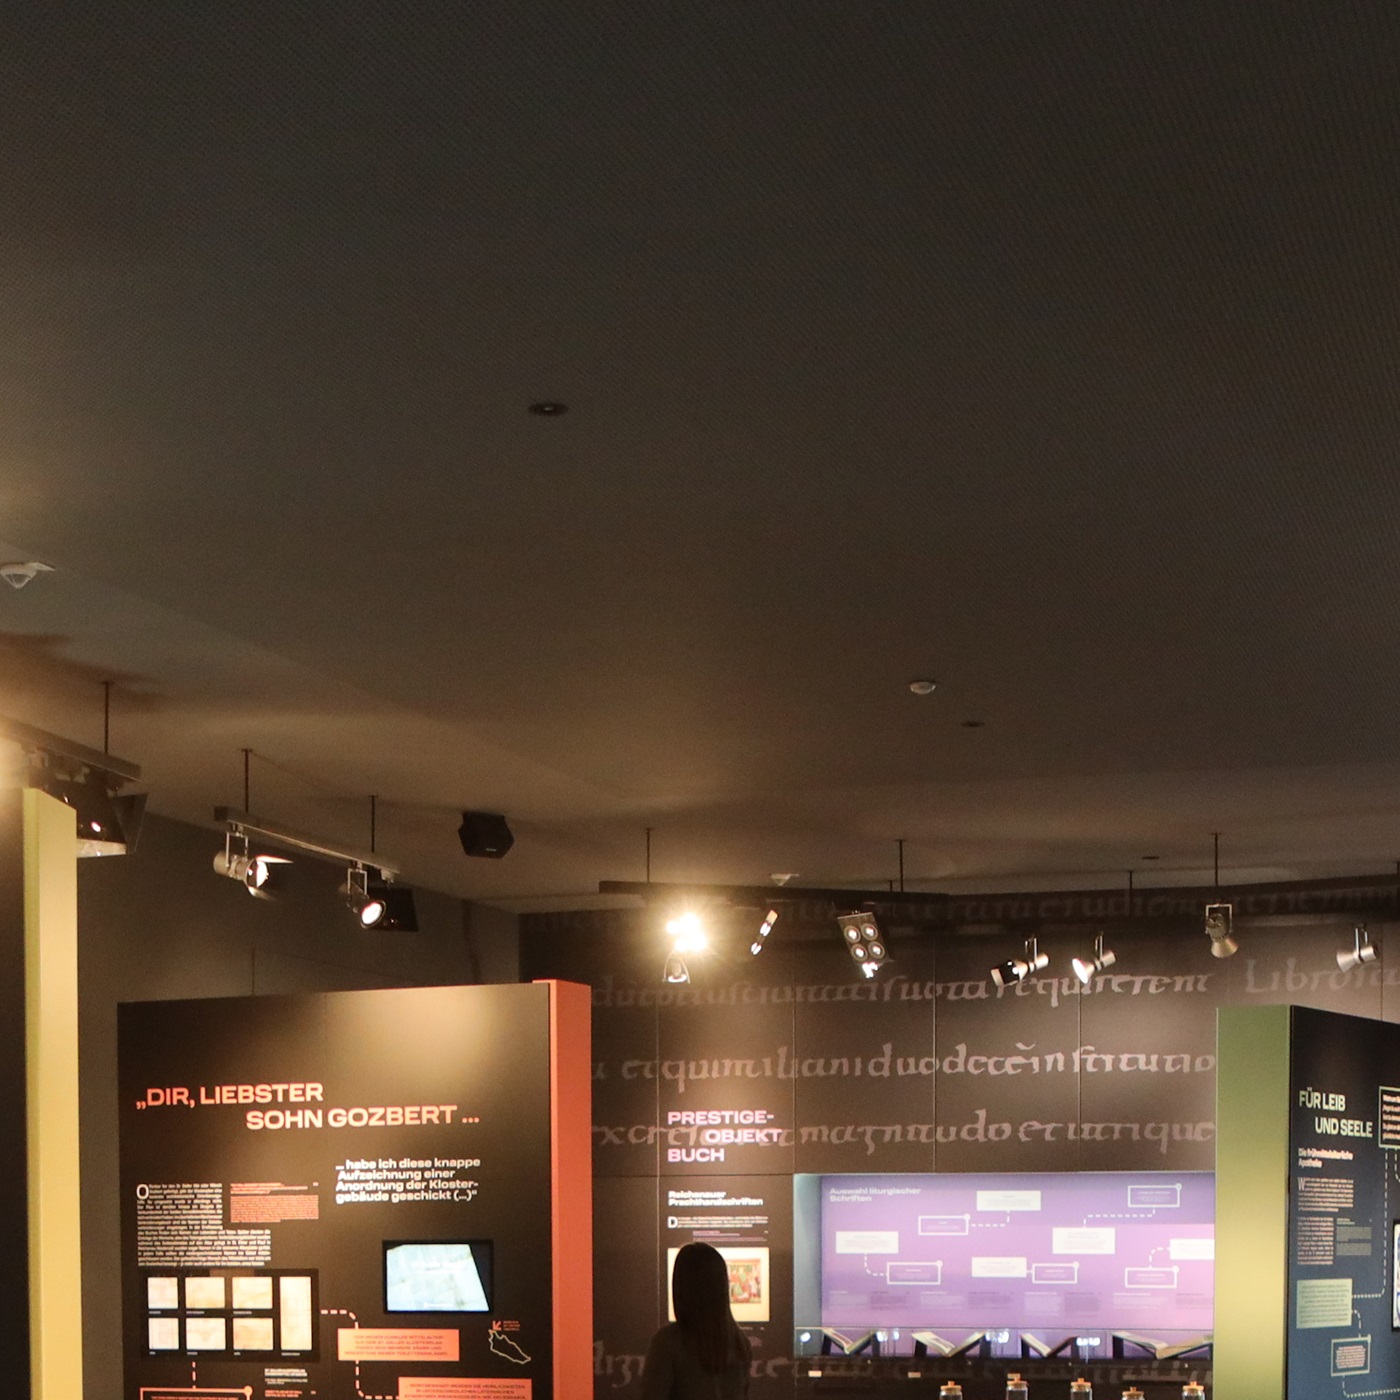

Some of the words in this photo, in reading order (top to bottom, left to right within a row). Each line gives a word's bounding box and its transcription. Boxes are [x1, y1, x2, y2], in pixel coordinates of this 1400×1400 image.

[135, 1087, 196, 1110] „DIR,
[200, 1083, 324, 1105] LIEBSTER
[1299, 1087, 1321, 1110] FÜR
[1322, 1093, 1346, 1112] LEIB
[246, 1108, 323, 1131] SOHN
[327, 1105, 458, 1127] GOZBERT
[667, 1110, 774, 1125] PRESTIGE-
[1314, 1117, 1340, 1136] UND
[1340, 1118, 1373, 1138] SEELE
[705, 1128, 783, 1143] OBJEKT
[667, 1148, 725, 1162] BUCH
[345, 1159, 376, 1169] habe
[378, 1159, 396, 1169] ich
[399, 1158, 432, 1168] diese
[434, 1158, 481, 1169] knappe
[337, 1169, 422, 1180] Aufzeichnung
[424, 1169, 455, 1178] einer
[335, 1181, 404, 1191] Anordnung
[405, 1180, 427, 1190] der
[429, 1179, 479, 1188] Kloster-
[829, 1187, 869, 1195] Auswahl
[869, 1186, 922, 1196] liturgischer
[335, 1191, 389, 1204] gebäude
[391, 1190, 451, 1203] geschickt
[668, 1191, 727, 1199] Reichenauer
[668, 1197, 763, 1207] Prachthandschriften
[829, 1194, 873, 1202] Schriften
